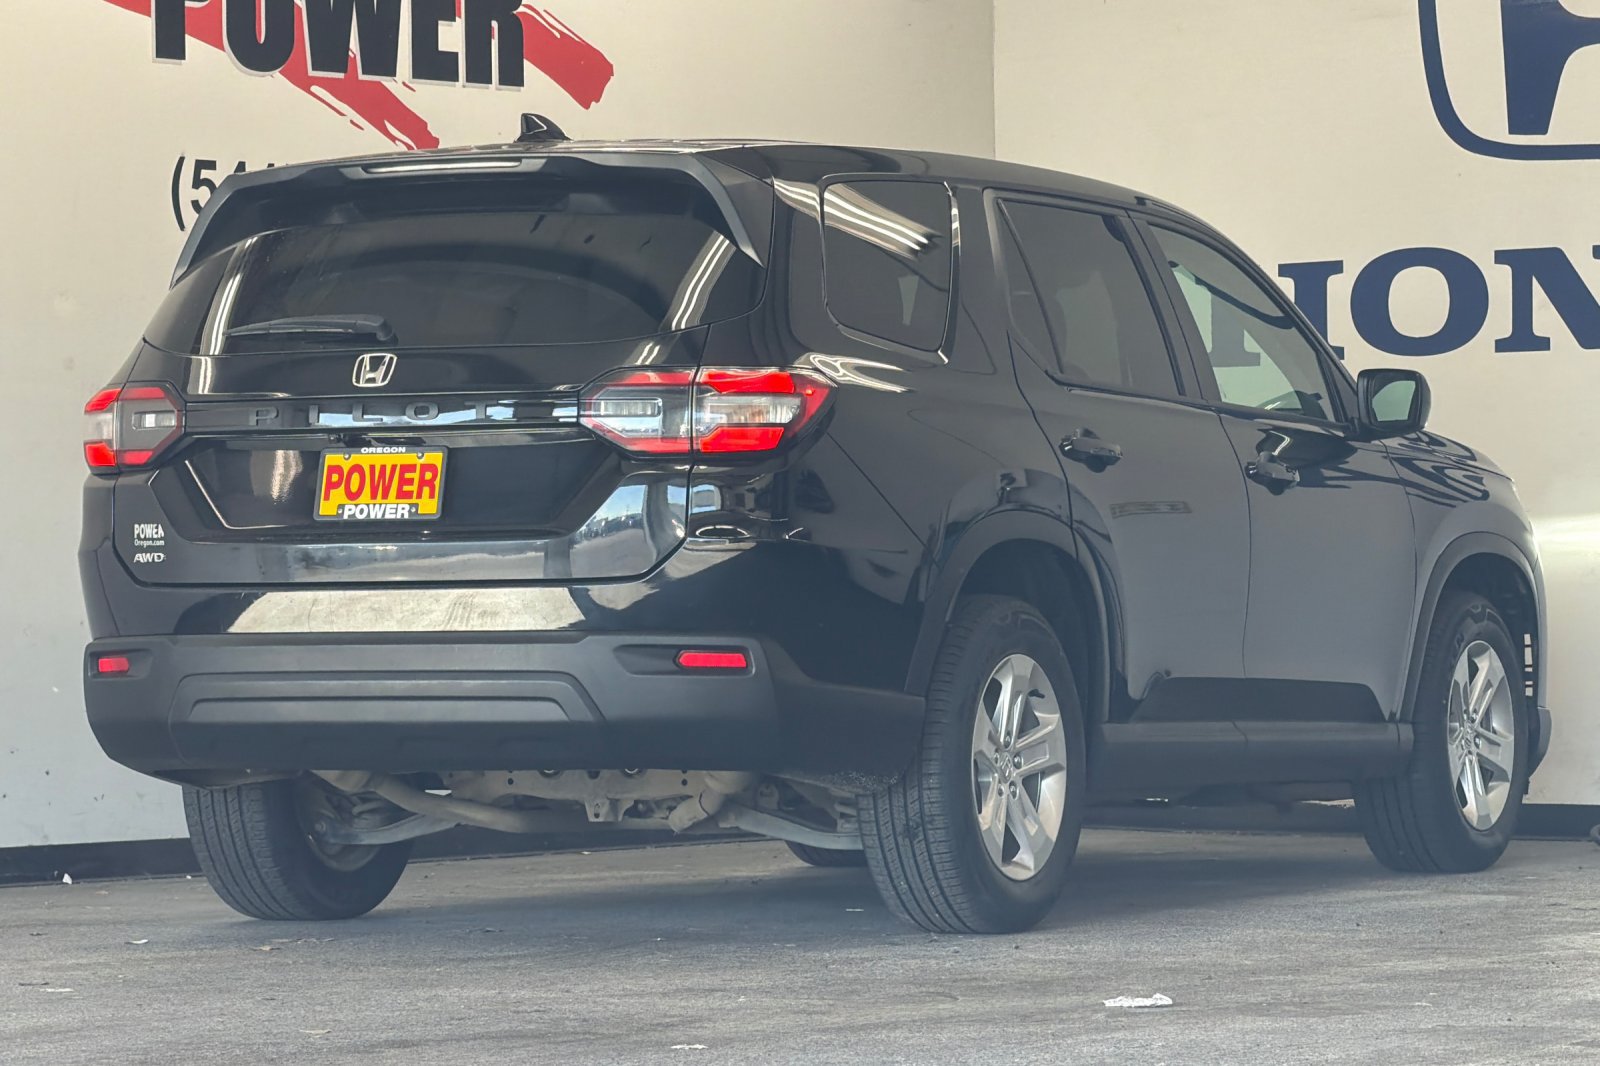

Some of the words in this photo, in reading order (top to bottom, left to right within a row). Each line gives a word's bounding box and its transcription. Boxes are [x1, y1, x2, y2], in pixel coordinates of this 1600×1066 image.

[253, 401, 499, 427] PILOT
[360, 446, 406, 454] OREGON
[323, 463, 439, 502] POWER
[343, 503, 410, 520] POWER
[134, 538, 165, 549] Oregon.com
[133, 552, 165, 563] AWD
